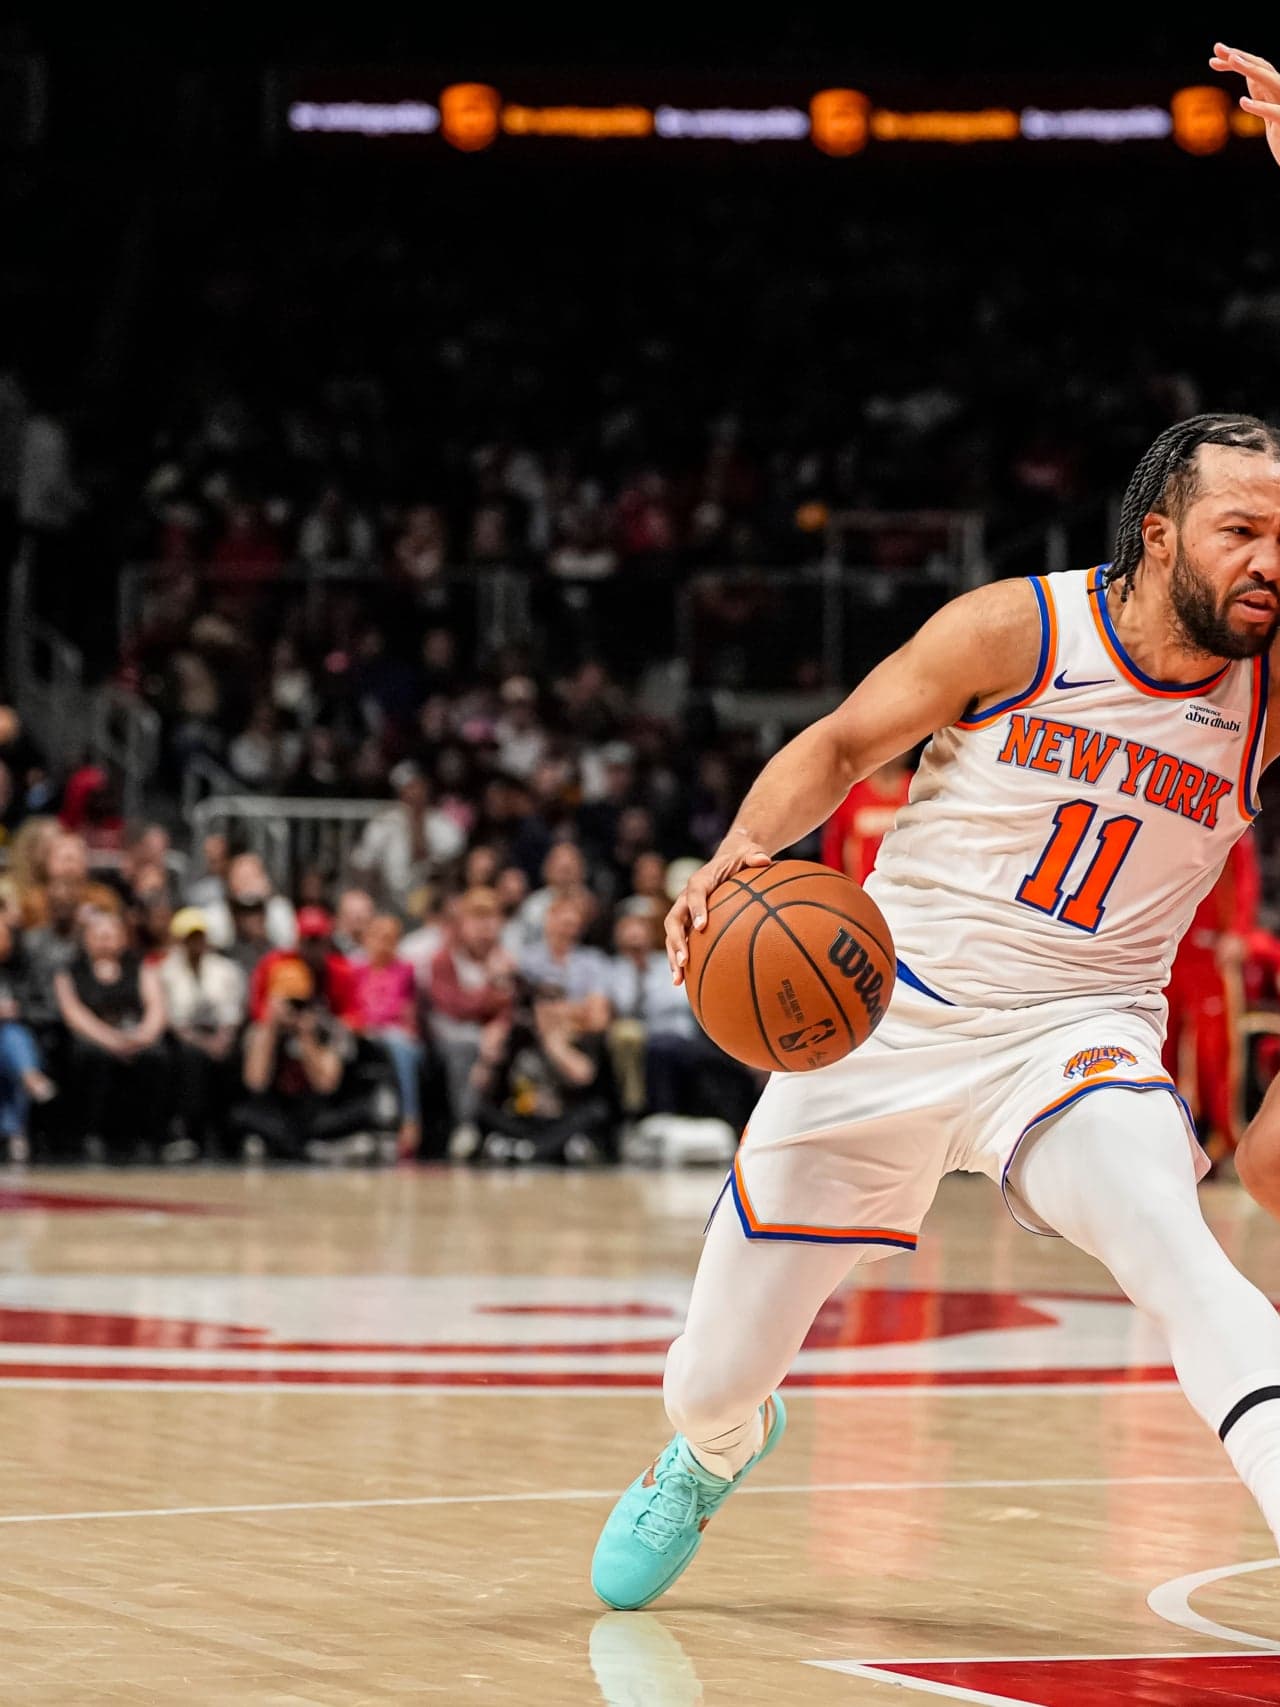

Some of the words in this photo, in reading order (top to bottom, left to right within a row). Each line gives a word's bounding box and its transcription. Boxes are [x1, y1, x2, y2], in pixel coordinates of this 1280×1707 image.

[1185, 711, 1210, 725] abu
[1210, 717, 1242, 732] dhabi
[1189, 703, 1221, 716] experience
[998, 714, 1120, 784] NEW
[1120, 740, 1234, 831] YORK
[1014, 798, 1143, 934] 11
